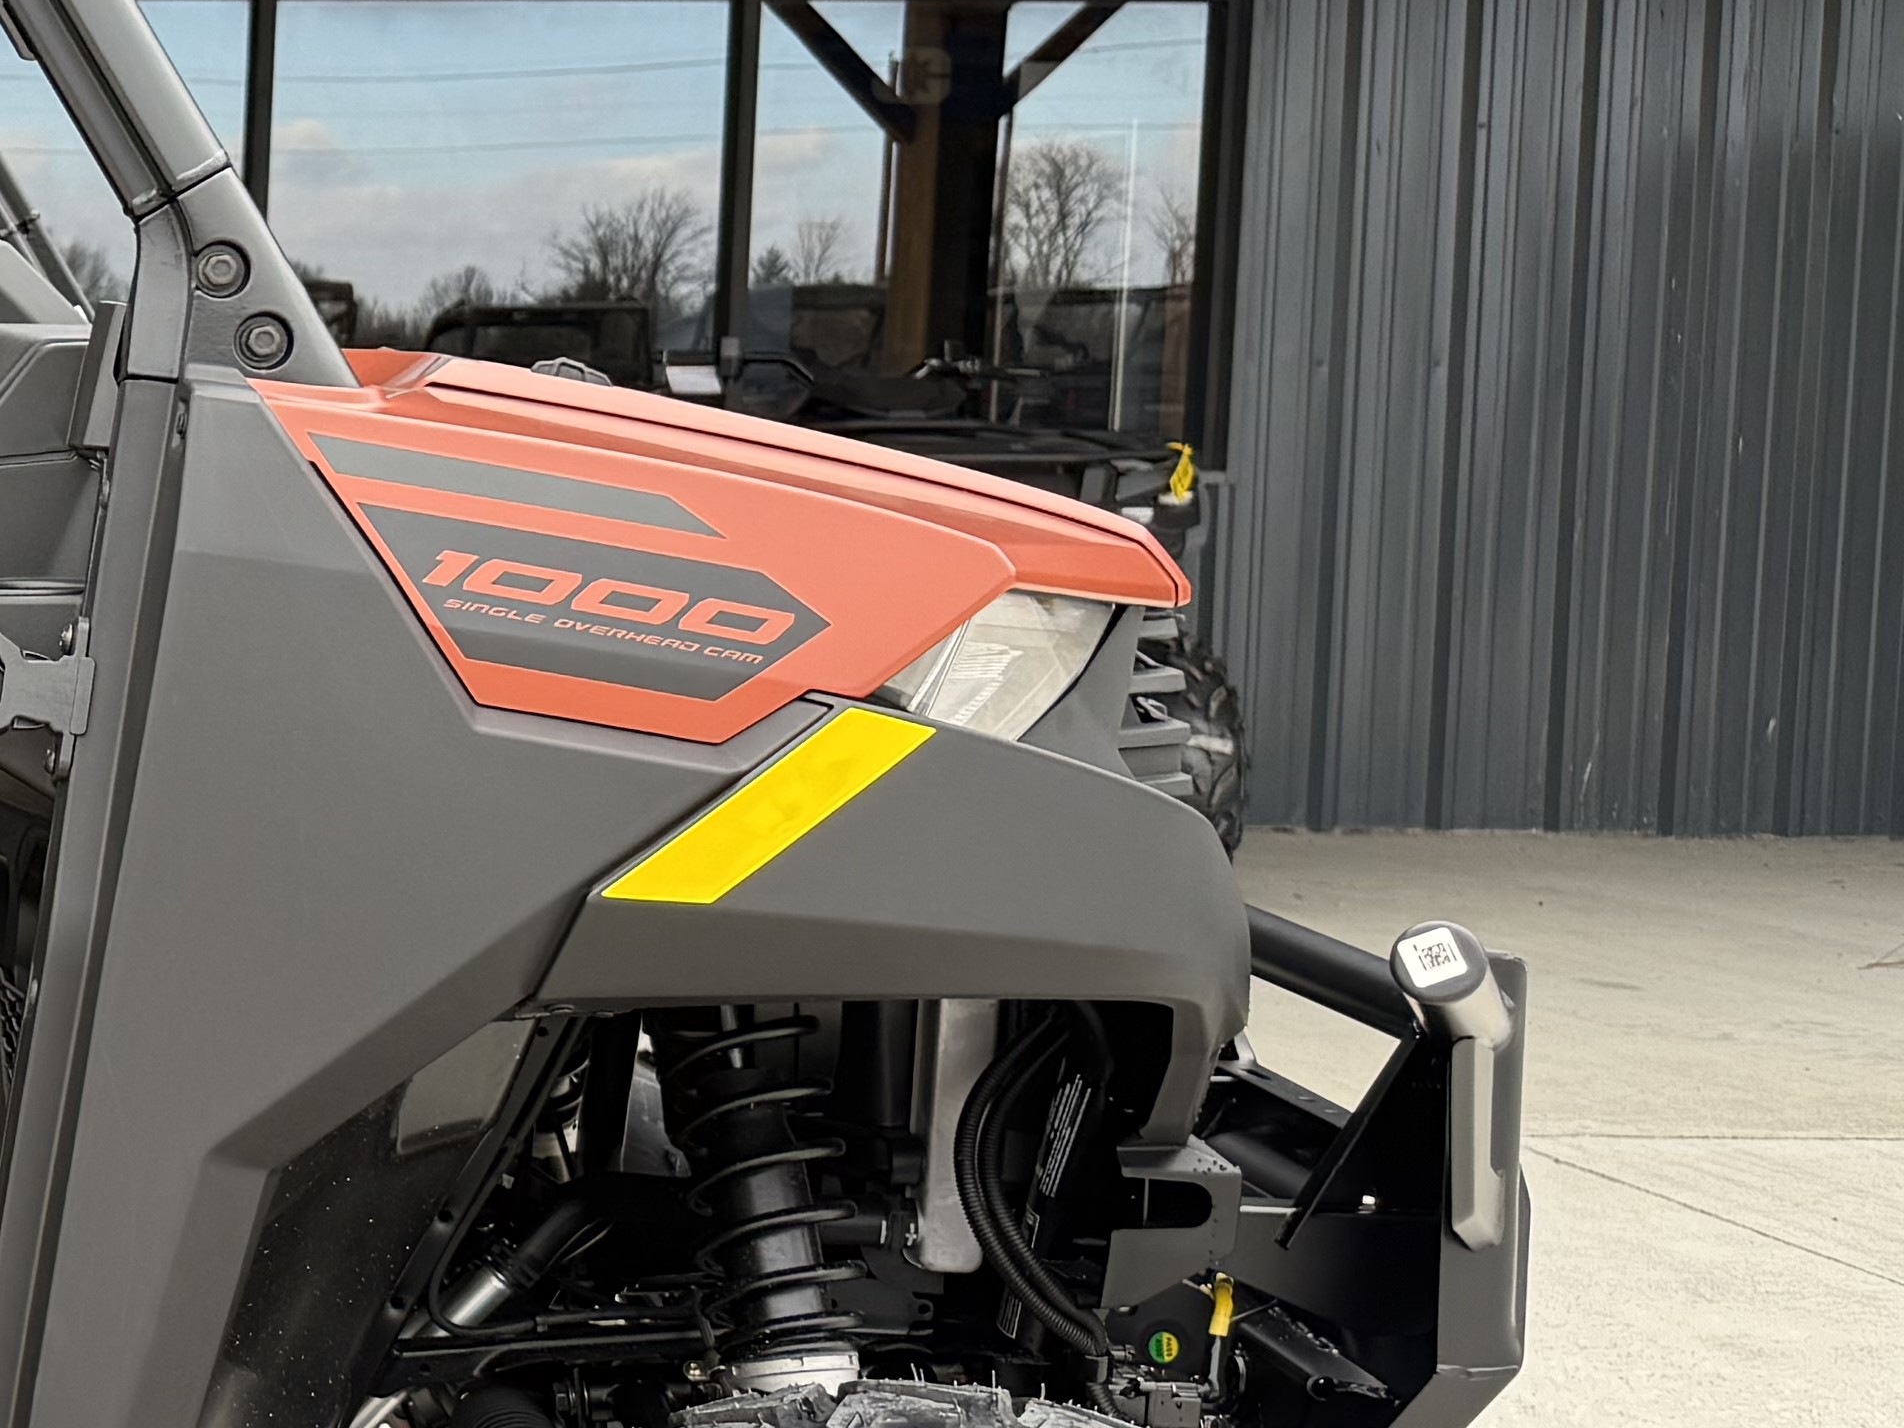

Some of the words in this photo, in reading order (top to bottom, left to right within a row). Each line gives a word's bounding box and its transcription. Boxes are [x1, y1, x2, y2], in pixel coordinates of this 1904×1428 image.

[422, 549, 795, 645] 1000
[443, 597, 546, 625] SINGLE
[553, 617, 700, 653] OVERHEAD
[702, 644, 764, 665] CAM
